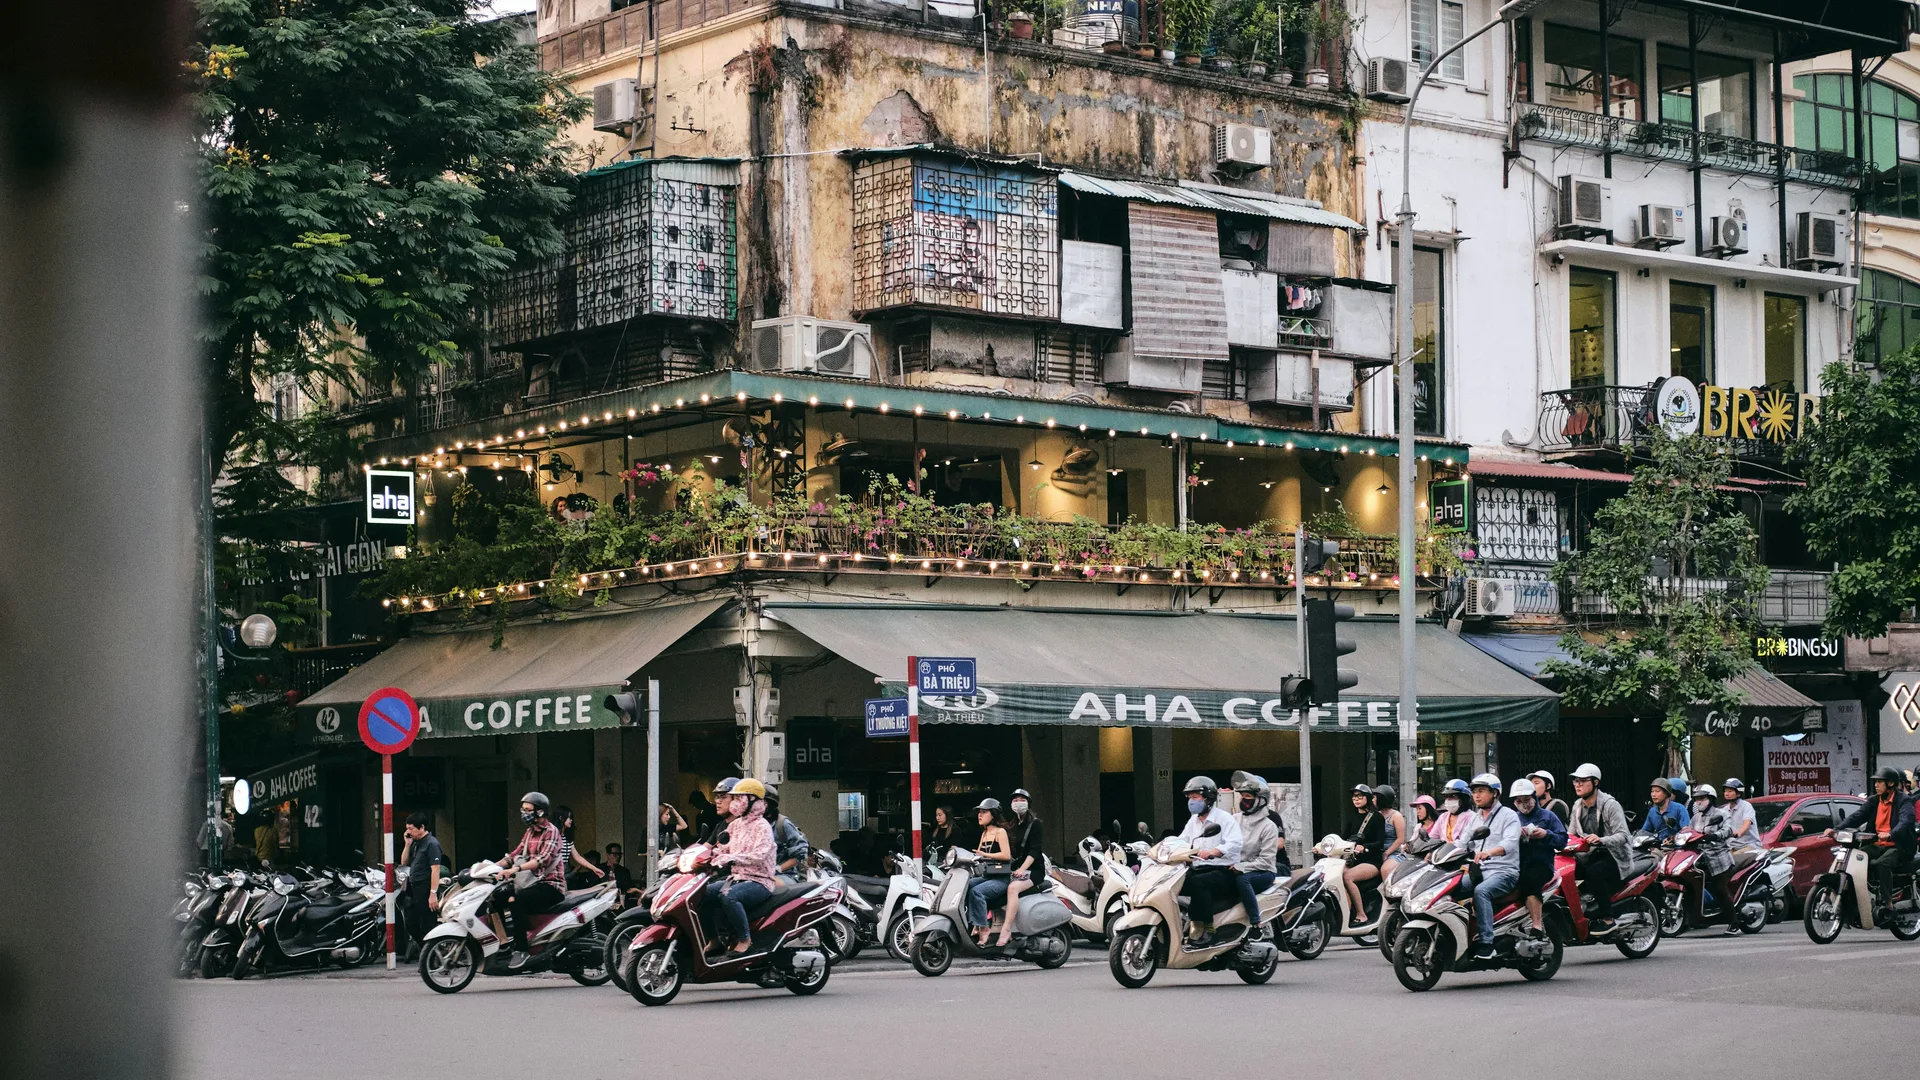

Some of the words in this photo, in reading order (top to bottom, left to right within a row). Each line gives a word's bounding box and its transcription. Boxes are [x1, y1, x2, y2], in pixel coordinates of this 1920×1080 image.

[372, 485, 409, 510] aha
[1434, 496, 1464, 519] aha
[937, 662, 956, 673] PHỐ
[923, 673, 938, 689] BÀ
[940, 673, 970, 692] TRIỆU
[463, 694, 592, 731] COFFEE
[880, 702, 894, 713] PHỐ
[937, 711, 952, 722] BÀ
[1069, 692, 1202, 723] AHA
[320, 709, 335, 731] 42
[868, 715, 875, 731] LÝ
[896, 713, 908, 731] KIỆT
[1750, 715, 1772, 732] 40
[796, 738, 832, 763] aha
[1768, 751, 1830, 766] PHOTOCOPY
[270, 774, 288, 801] AHA
[288, 764, 318, 794] COFFEE
[1780, 770, 1797, 781] Sang
[1797, 770, 1808, 781] địa
[811, 790, 821, 799] 40
[304, 804, 320, 828] 42
